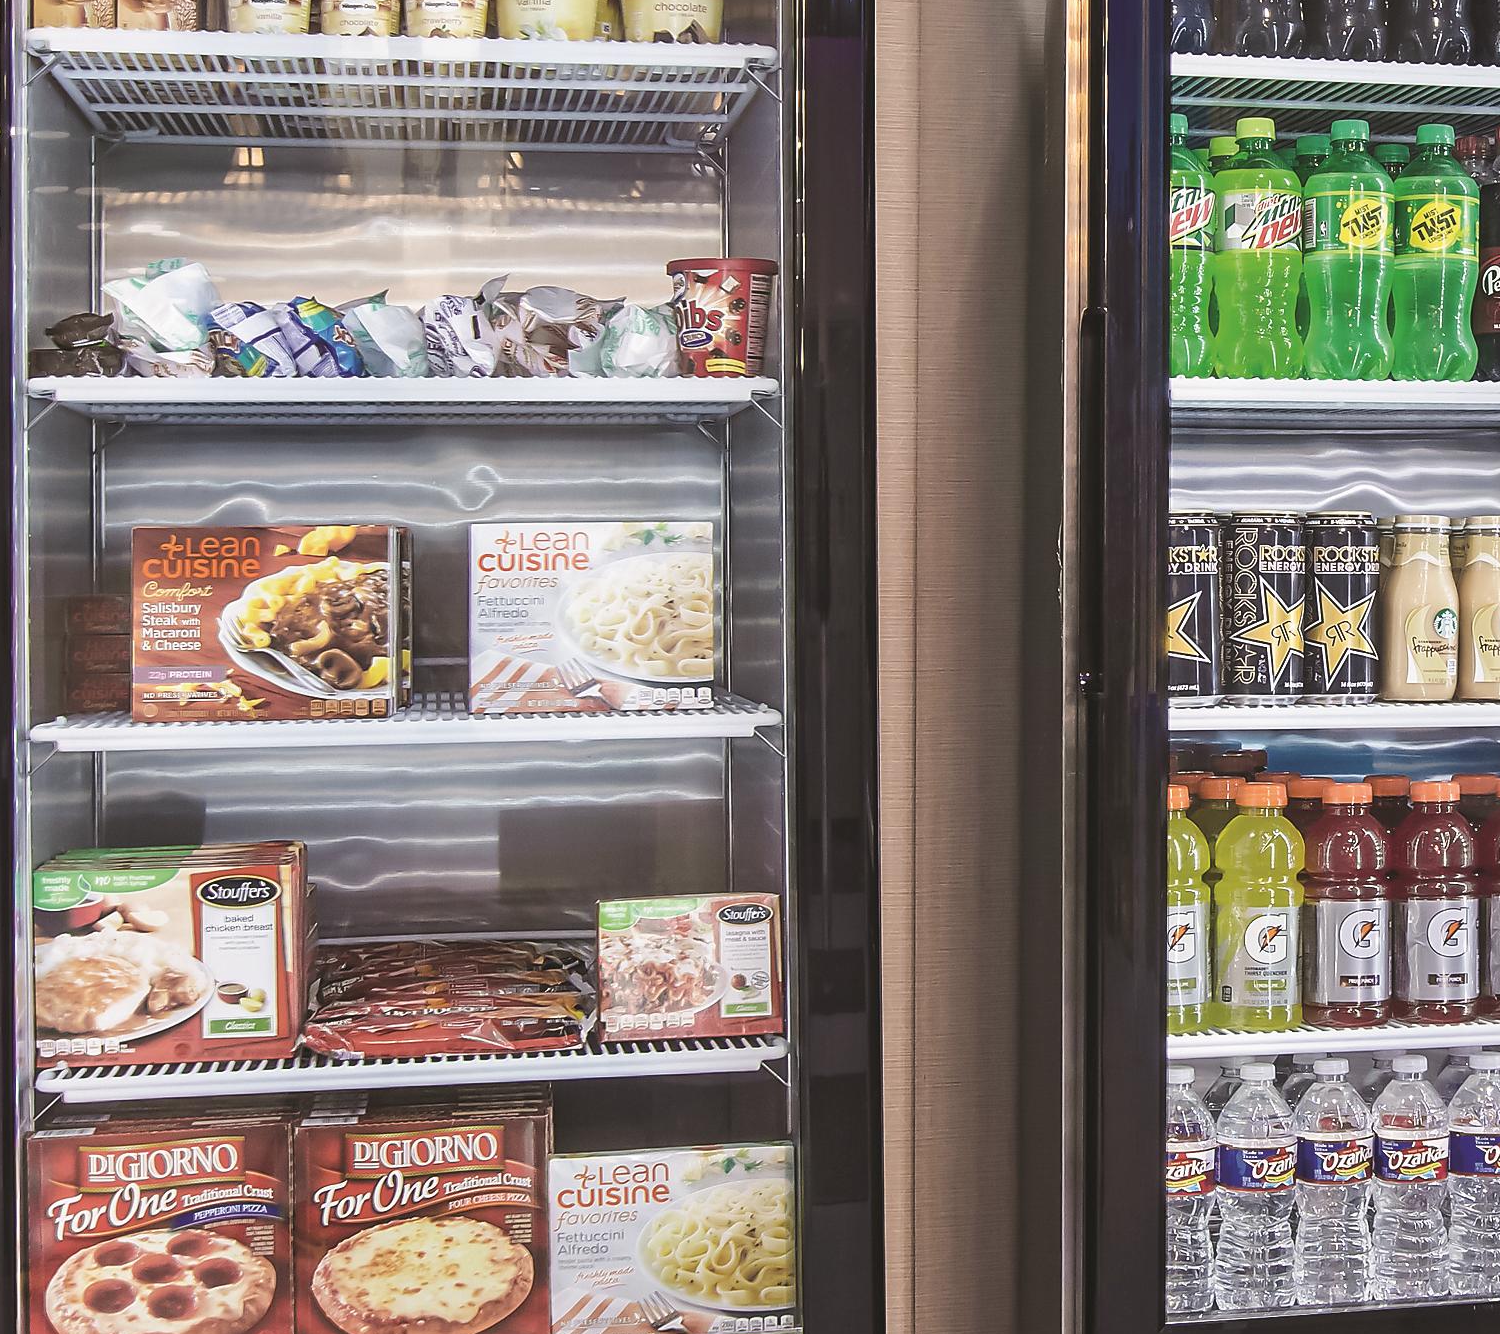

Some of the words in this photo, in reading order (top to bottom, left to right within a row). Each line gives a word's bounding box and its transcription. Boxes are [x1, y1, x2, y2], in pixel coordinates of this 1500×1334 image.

[1315, 562, 1354, 574] ENERGY
[142, 581, 214, 602] Comfort
[474, 574, 559, 595] favorites
[142, 602, 202, 616] Salisbury
[142, 615, 178, 627] Steak
[181, 617, 201, 626] with
[142, 627, 201, 639] Macaroni
[142, 640, 152, 651] &
[154, 639, 202, 651] Cheese
[169, 669, 213, 680] PROTEIN
[206, 880, 271, 903] Stouffer's
[224, 914, 255, 924] baked
[205, 923, 242, 933] chicken
[243, 923, 274, 932] breast
[1339, 909, 1381, 960] G
[1244, 914, 1288, 965] G
[442, 1173, 502, 1195] Traditional
[503, 1172, 533, 1189] Crust
[181, 1186, 243, 1208] Traditional
[243, 1186, 274, 1201] Crust
[314, 1184, 374, 1228] For
[373, 1169, 440, 1212] One
[48, 1197, 107, 1242] For
[106, 1184, 177, 1226] One
[193, 1205, 242, 1221] PEPPERONI
[242, 1203, 268, 1216] PIZZA
[556, 1228, 626, 1244] Fettuccini
[556, 1240, 609, 1256] Alfredo
